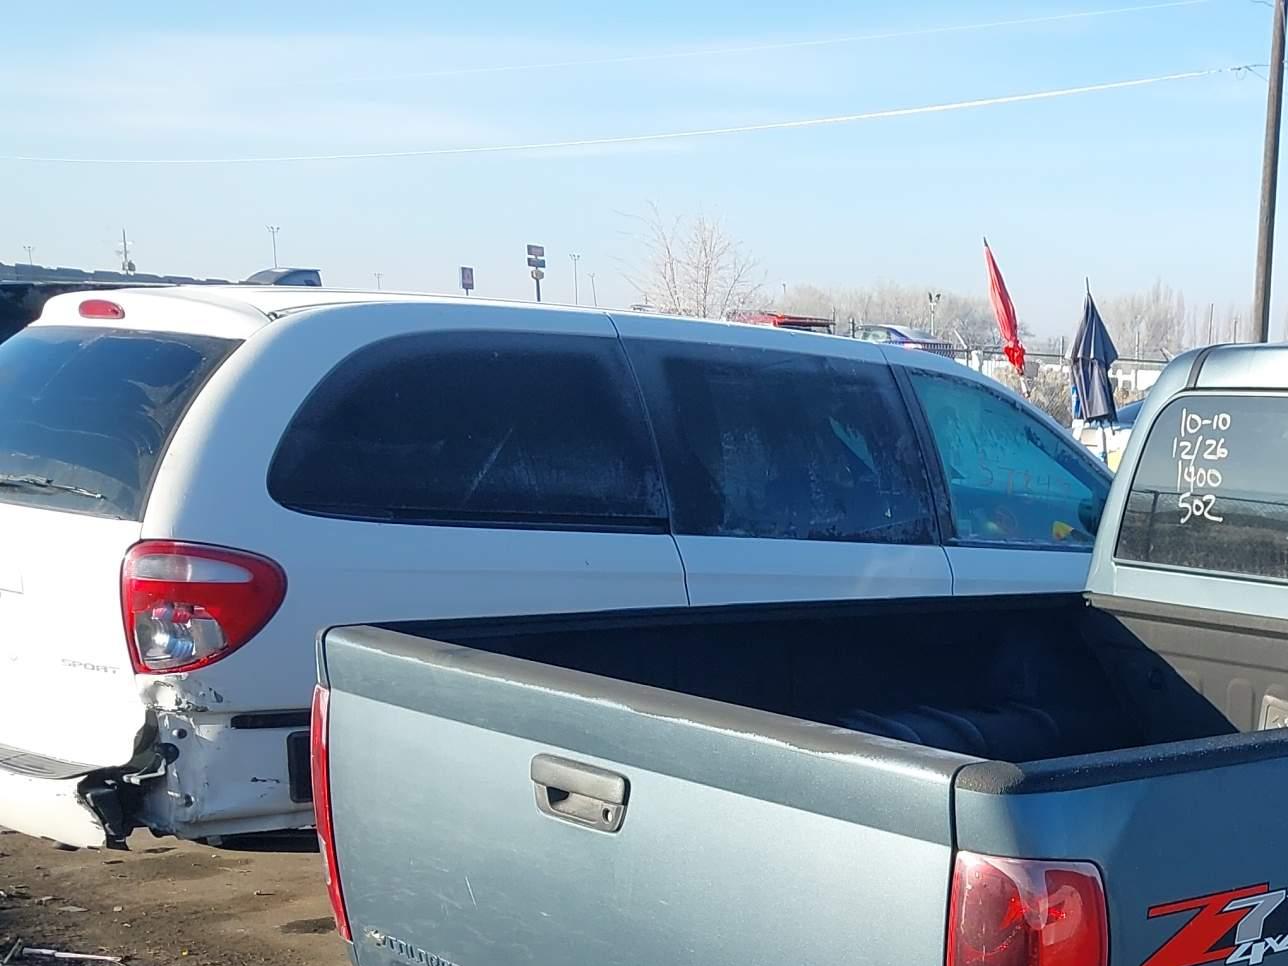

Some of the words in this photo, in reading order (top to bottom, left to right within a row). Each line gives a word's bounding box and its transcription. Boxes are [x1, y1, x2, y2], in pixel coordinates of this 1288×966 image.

[1180, 408, 1231, 437] 10-10
[1173, 436, 1228, 463] 12/26
[1176, 459, 1222, 493] 1400
[1178, 491, 1223, 524] 502
